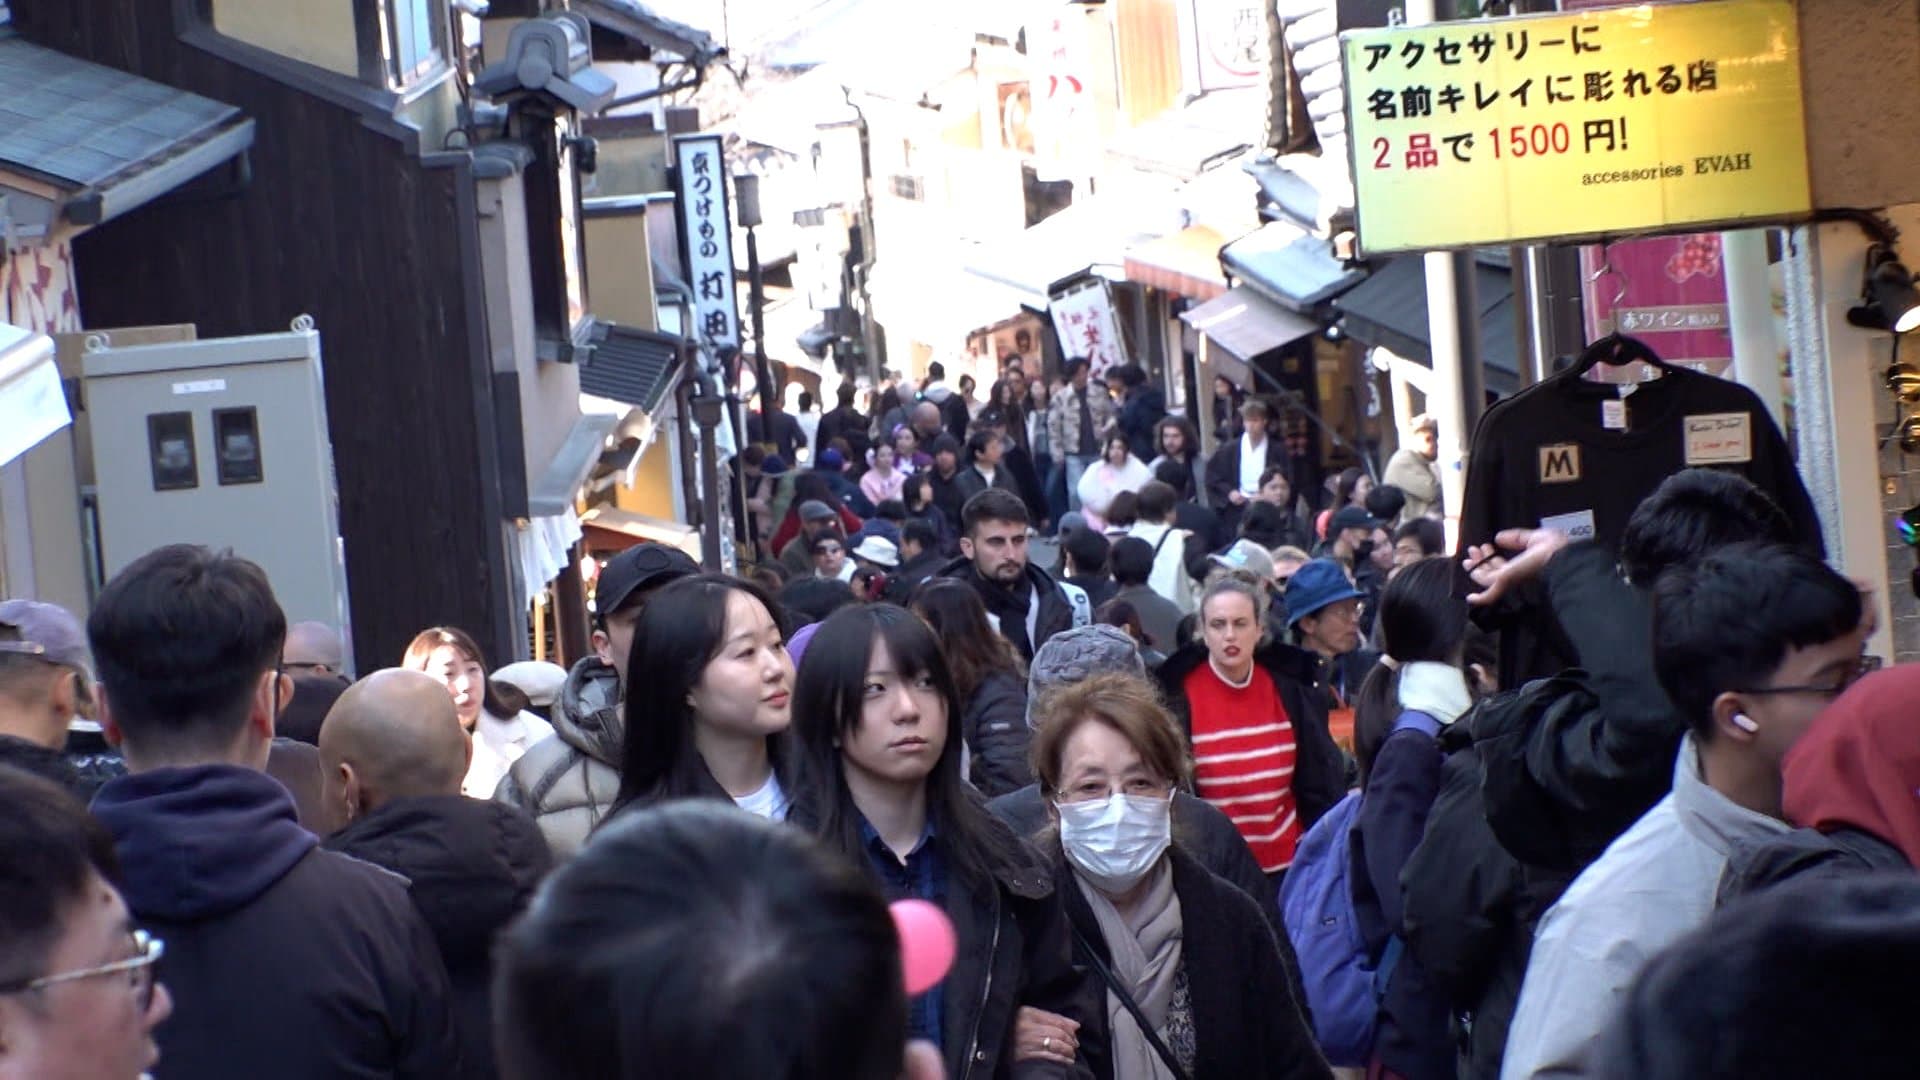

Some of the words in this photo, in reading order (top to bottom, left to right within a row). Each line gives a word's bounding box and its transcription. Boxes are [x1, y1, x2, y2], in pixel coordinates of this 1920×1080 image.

[1363, 25, 1602, 72] アクセサリーに
[1367, 59, 1718, 120] 名前キレイに彫れる店
[1582, 162, 1684, 185] accessories
[1694, 153, 1753, 175] EVAH
[1544, 450, 1574, 478] M
